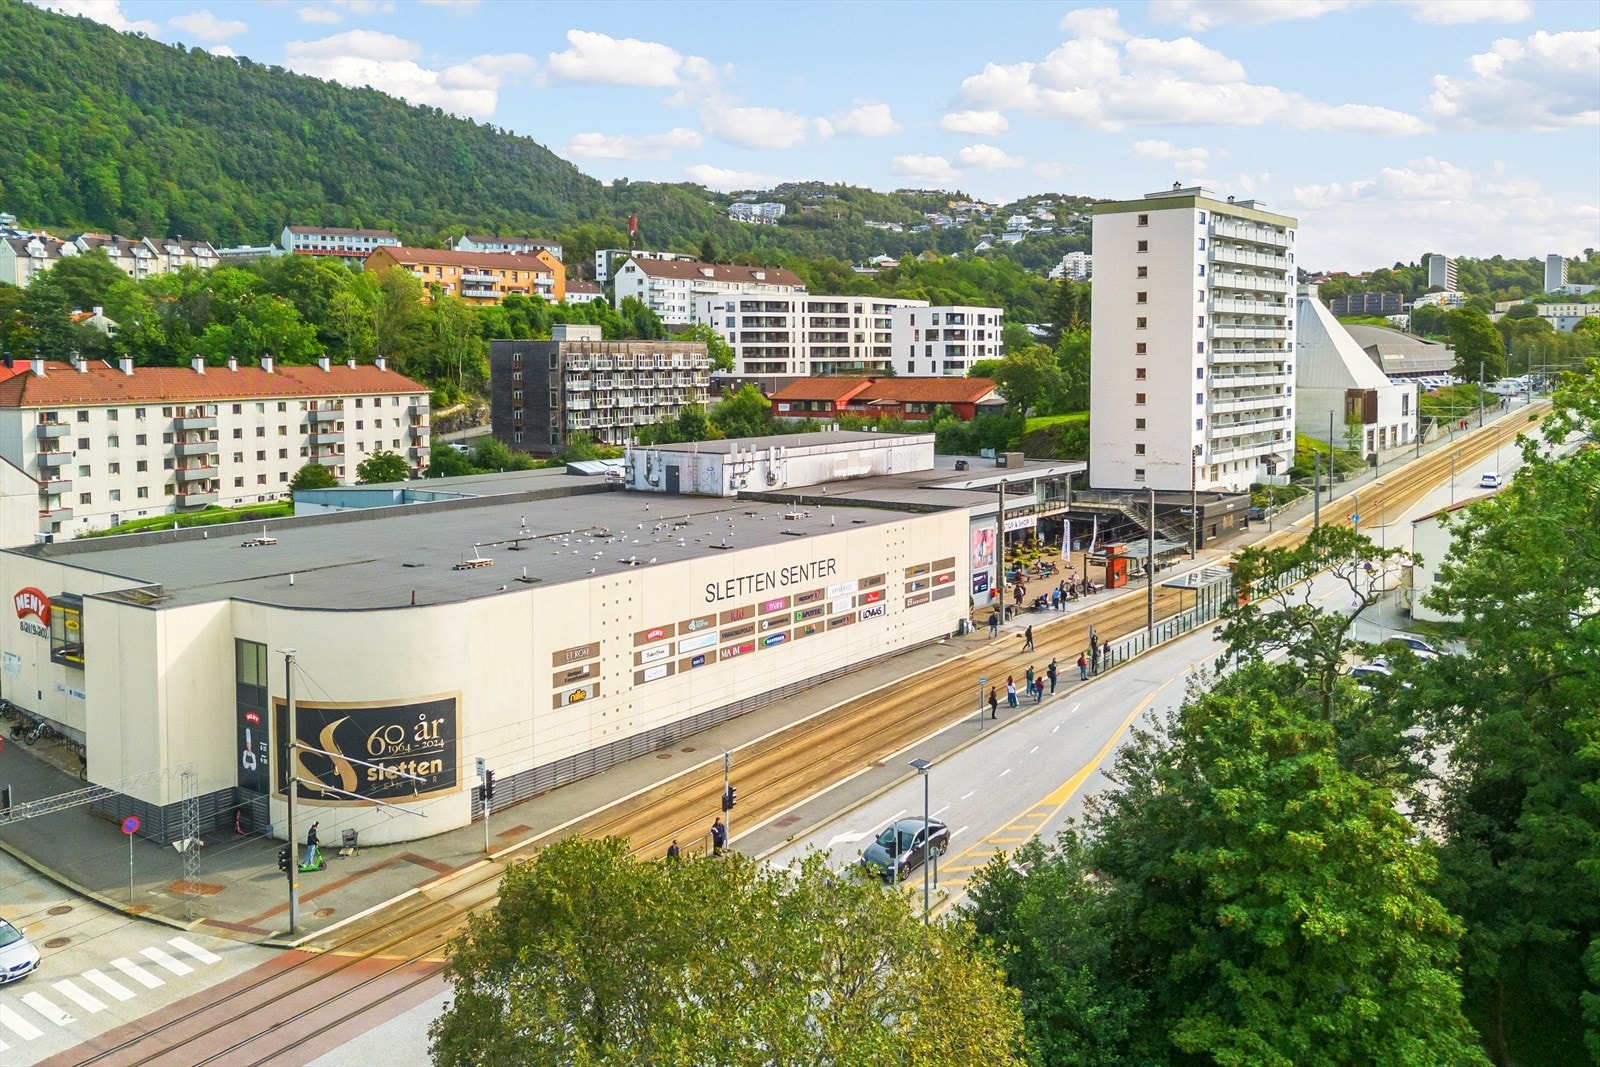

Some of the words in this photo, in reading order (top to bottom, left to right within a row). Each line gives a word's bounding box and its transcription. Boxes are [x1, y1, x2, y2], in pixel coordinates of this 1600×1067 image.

[705, 570, 776, 603] SLETTEN
[780, 558, 837, 586] SENTER
[16, 593, 45, 617] MENY
[647, 629, 664, 640] MENY
[568, 688, 587, 704] nille
[366, 724, 405, 756] 60
[413, 713, 445, 742] år
[387, 741, 411, 756] 1964
[421, 738, 445, 749] 2024
[366, 758, 443, 781] sletten
